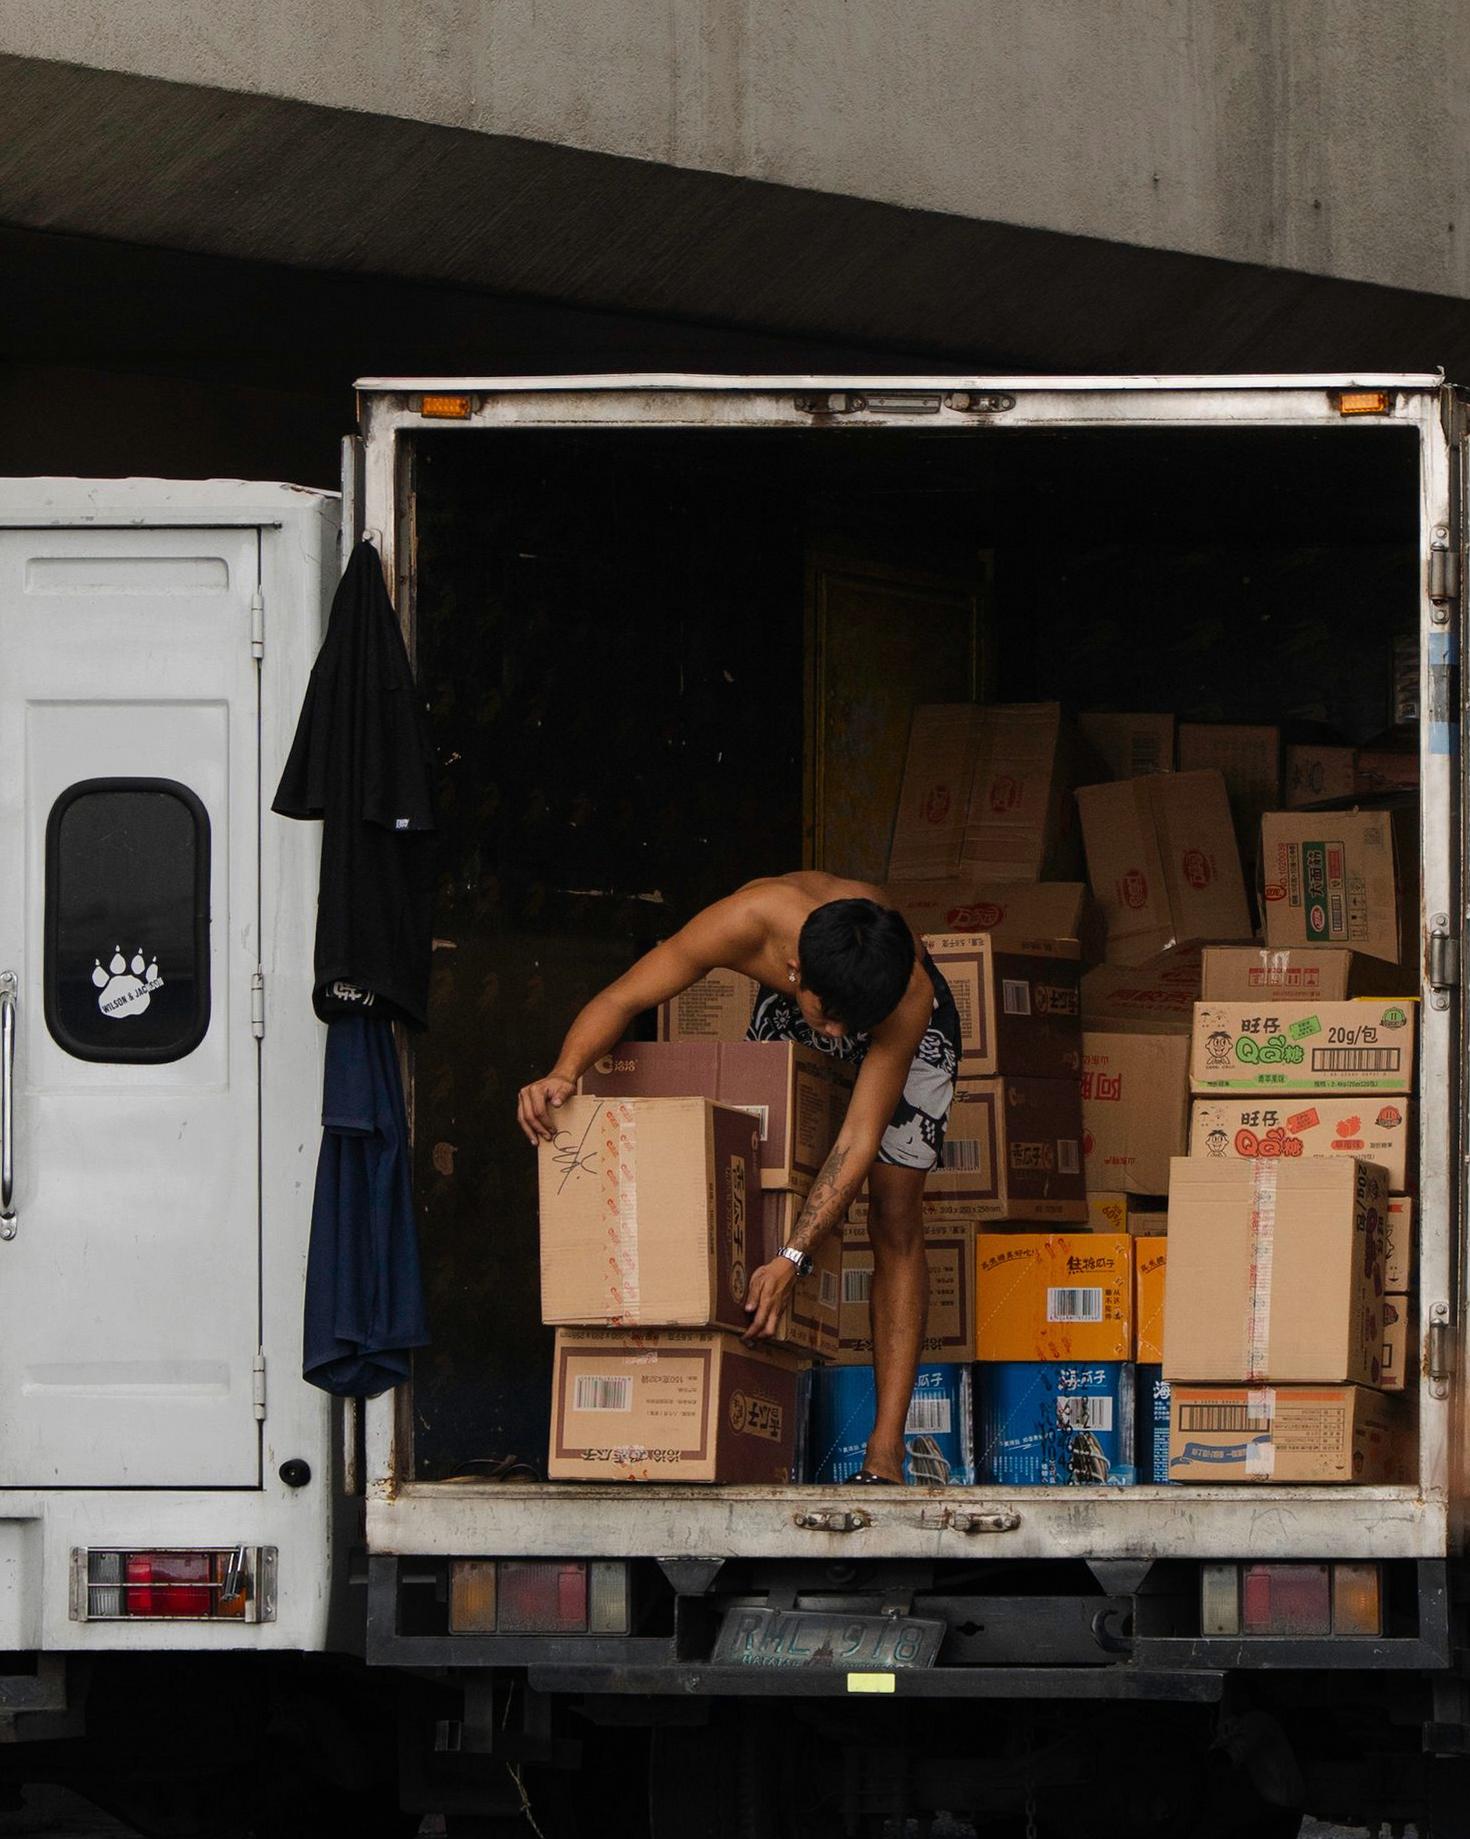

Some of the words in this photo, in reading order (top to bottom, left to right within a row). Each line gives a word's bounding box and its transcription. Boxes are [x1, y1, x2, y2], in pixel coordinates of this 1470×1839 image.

[102, 995, 128, 1013] WILSON
[128, 992, 134, 1001] &
[1241, 1016, 1280, 1034] 旺仔
[1328, 1025, 1378, 1045] 20g/包
[1241, 1110, 1279, 1127] 旺仔
[840, 1622, 925, 1662] 918
